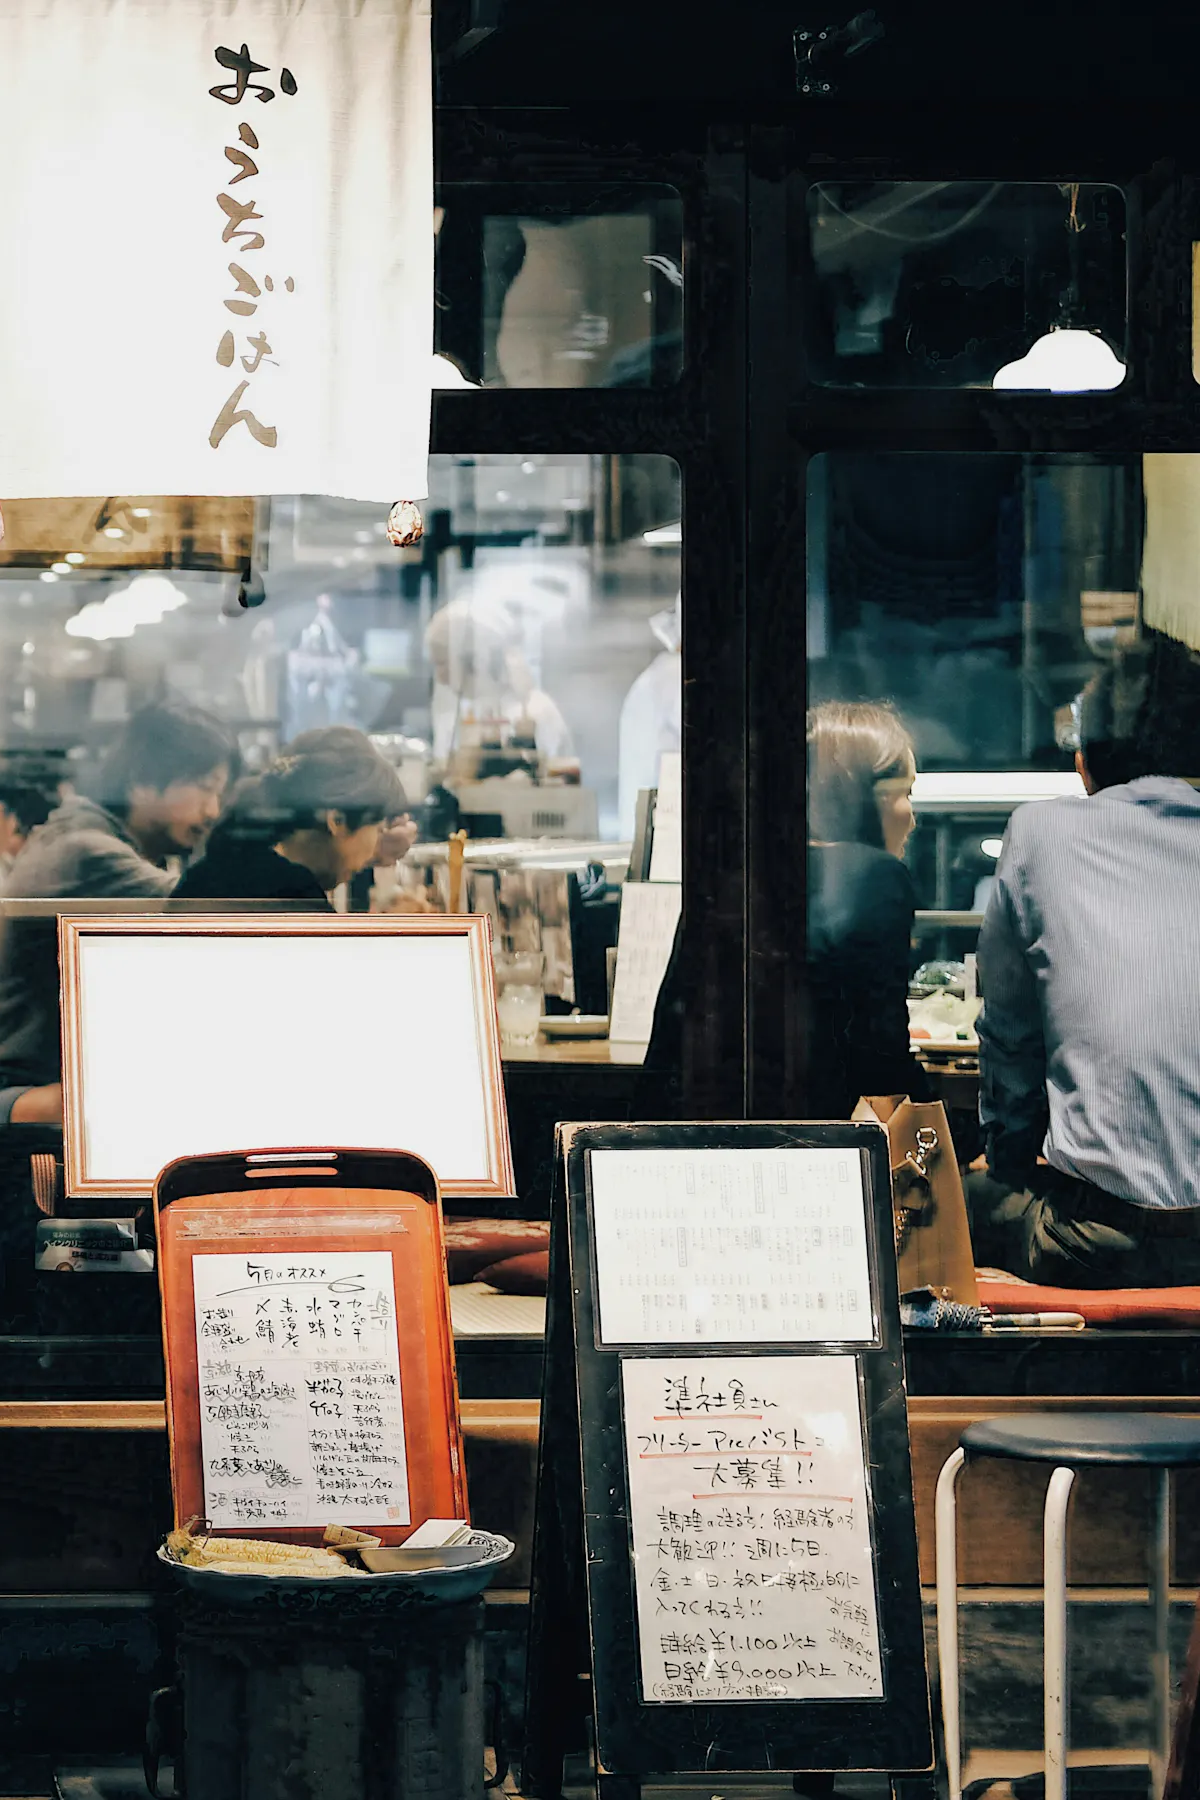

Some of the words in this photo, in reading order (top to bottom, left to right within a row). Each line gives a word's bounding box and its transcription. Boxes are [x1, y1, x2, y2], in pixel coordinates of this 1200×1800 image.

[208, 43, 298, 449] おうちごはん
[329, 1300, 344, 1337] マグロ
[347, 1299, 366, 1343] カンパチ
[664, 1376, 780, 1419] 準社員さん
